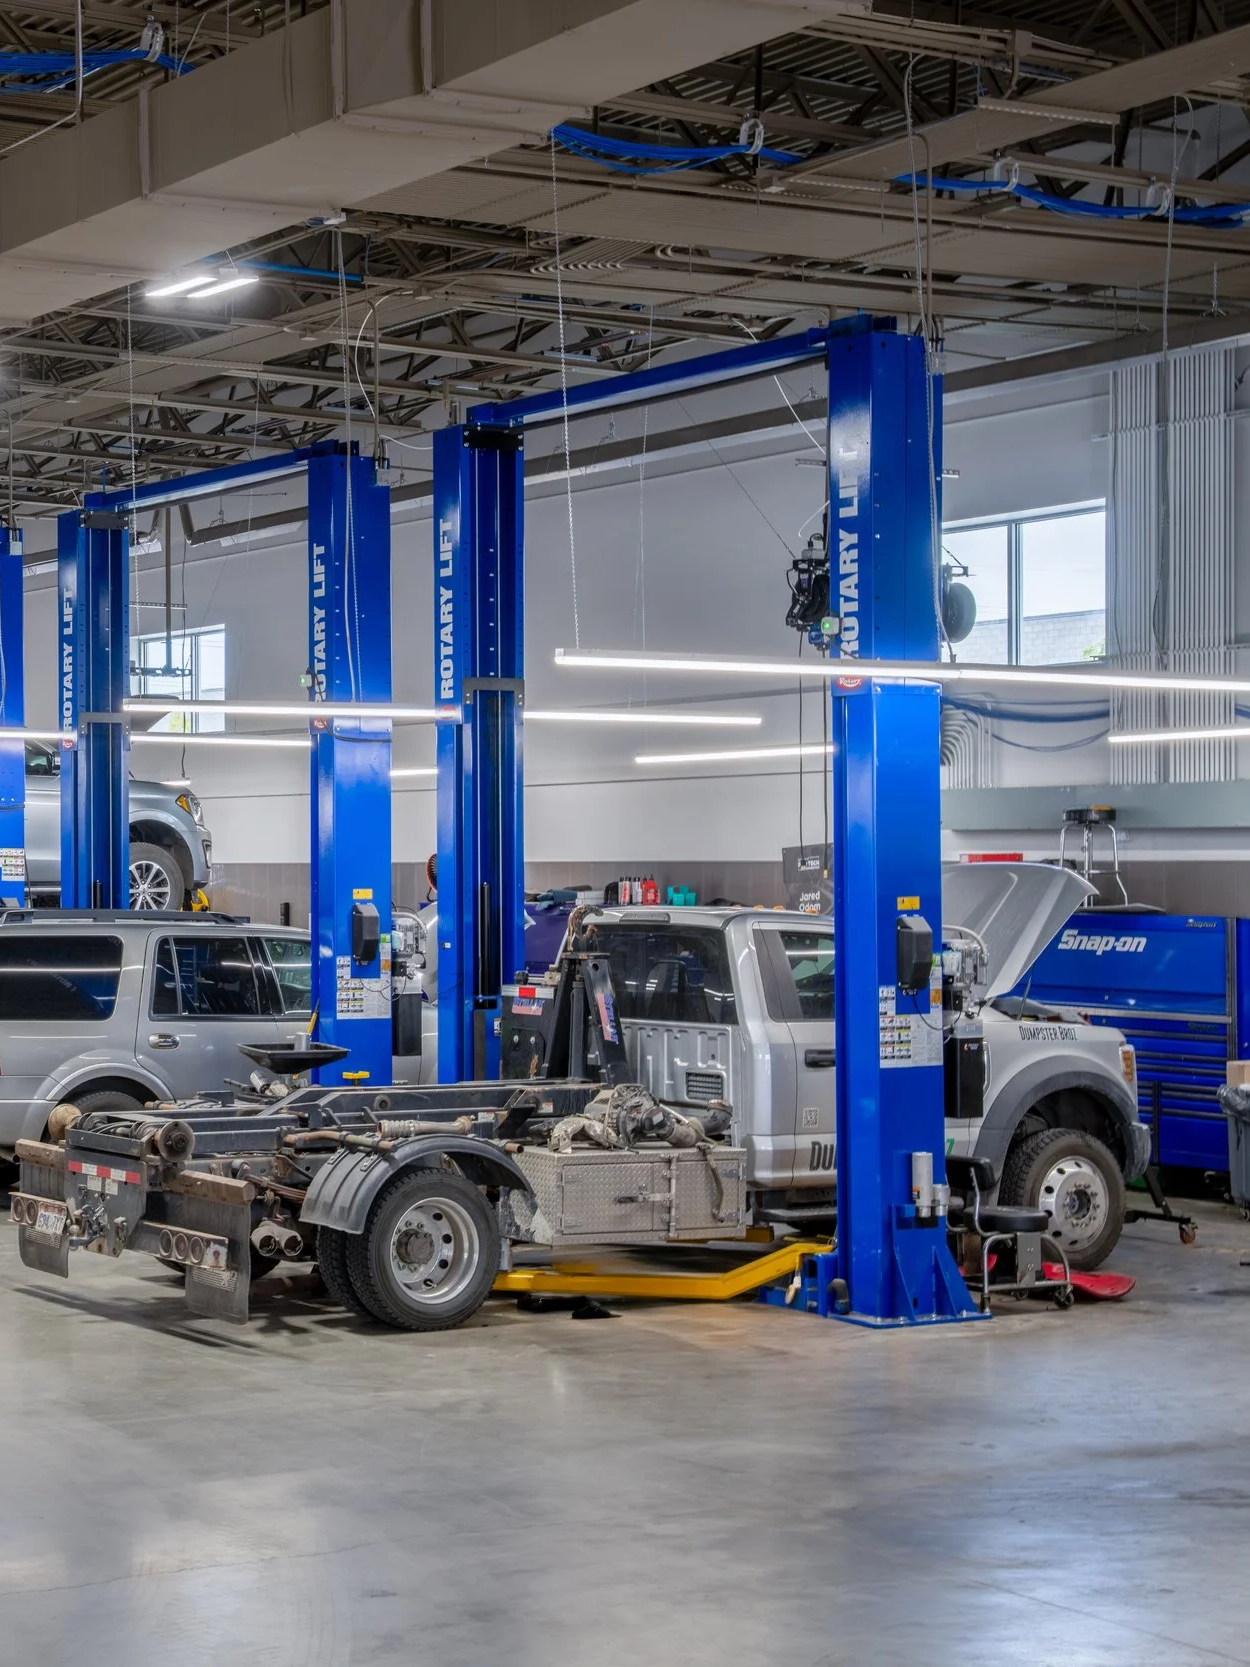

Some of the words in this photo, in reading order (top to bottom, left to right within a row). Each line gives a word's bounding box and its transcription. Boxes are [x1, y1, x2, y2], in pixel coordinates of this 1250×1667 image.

[313, 543, 326, 598] LIFT
[440, 519, 453, 577] LIFT
[63, 588, 73, 635] LIFT
[440, 587, 454, 699] ROTARY
[63, 642, 73, 735] ROTARY
[799, 891, 821, 902] Jared
[1058, 929, 1147, 955] Snap-on
[1019, 1026, 1059, 1041] DUMPSTER
